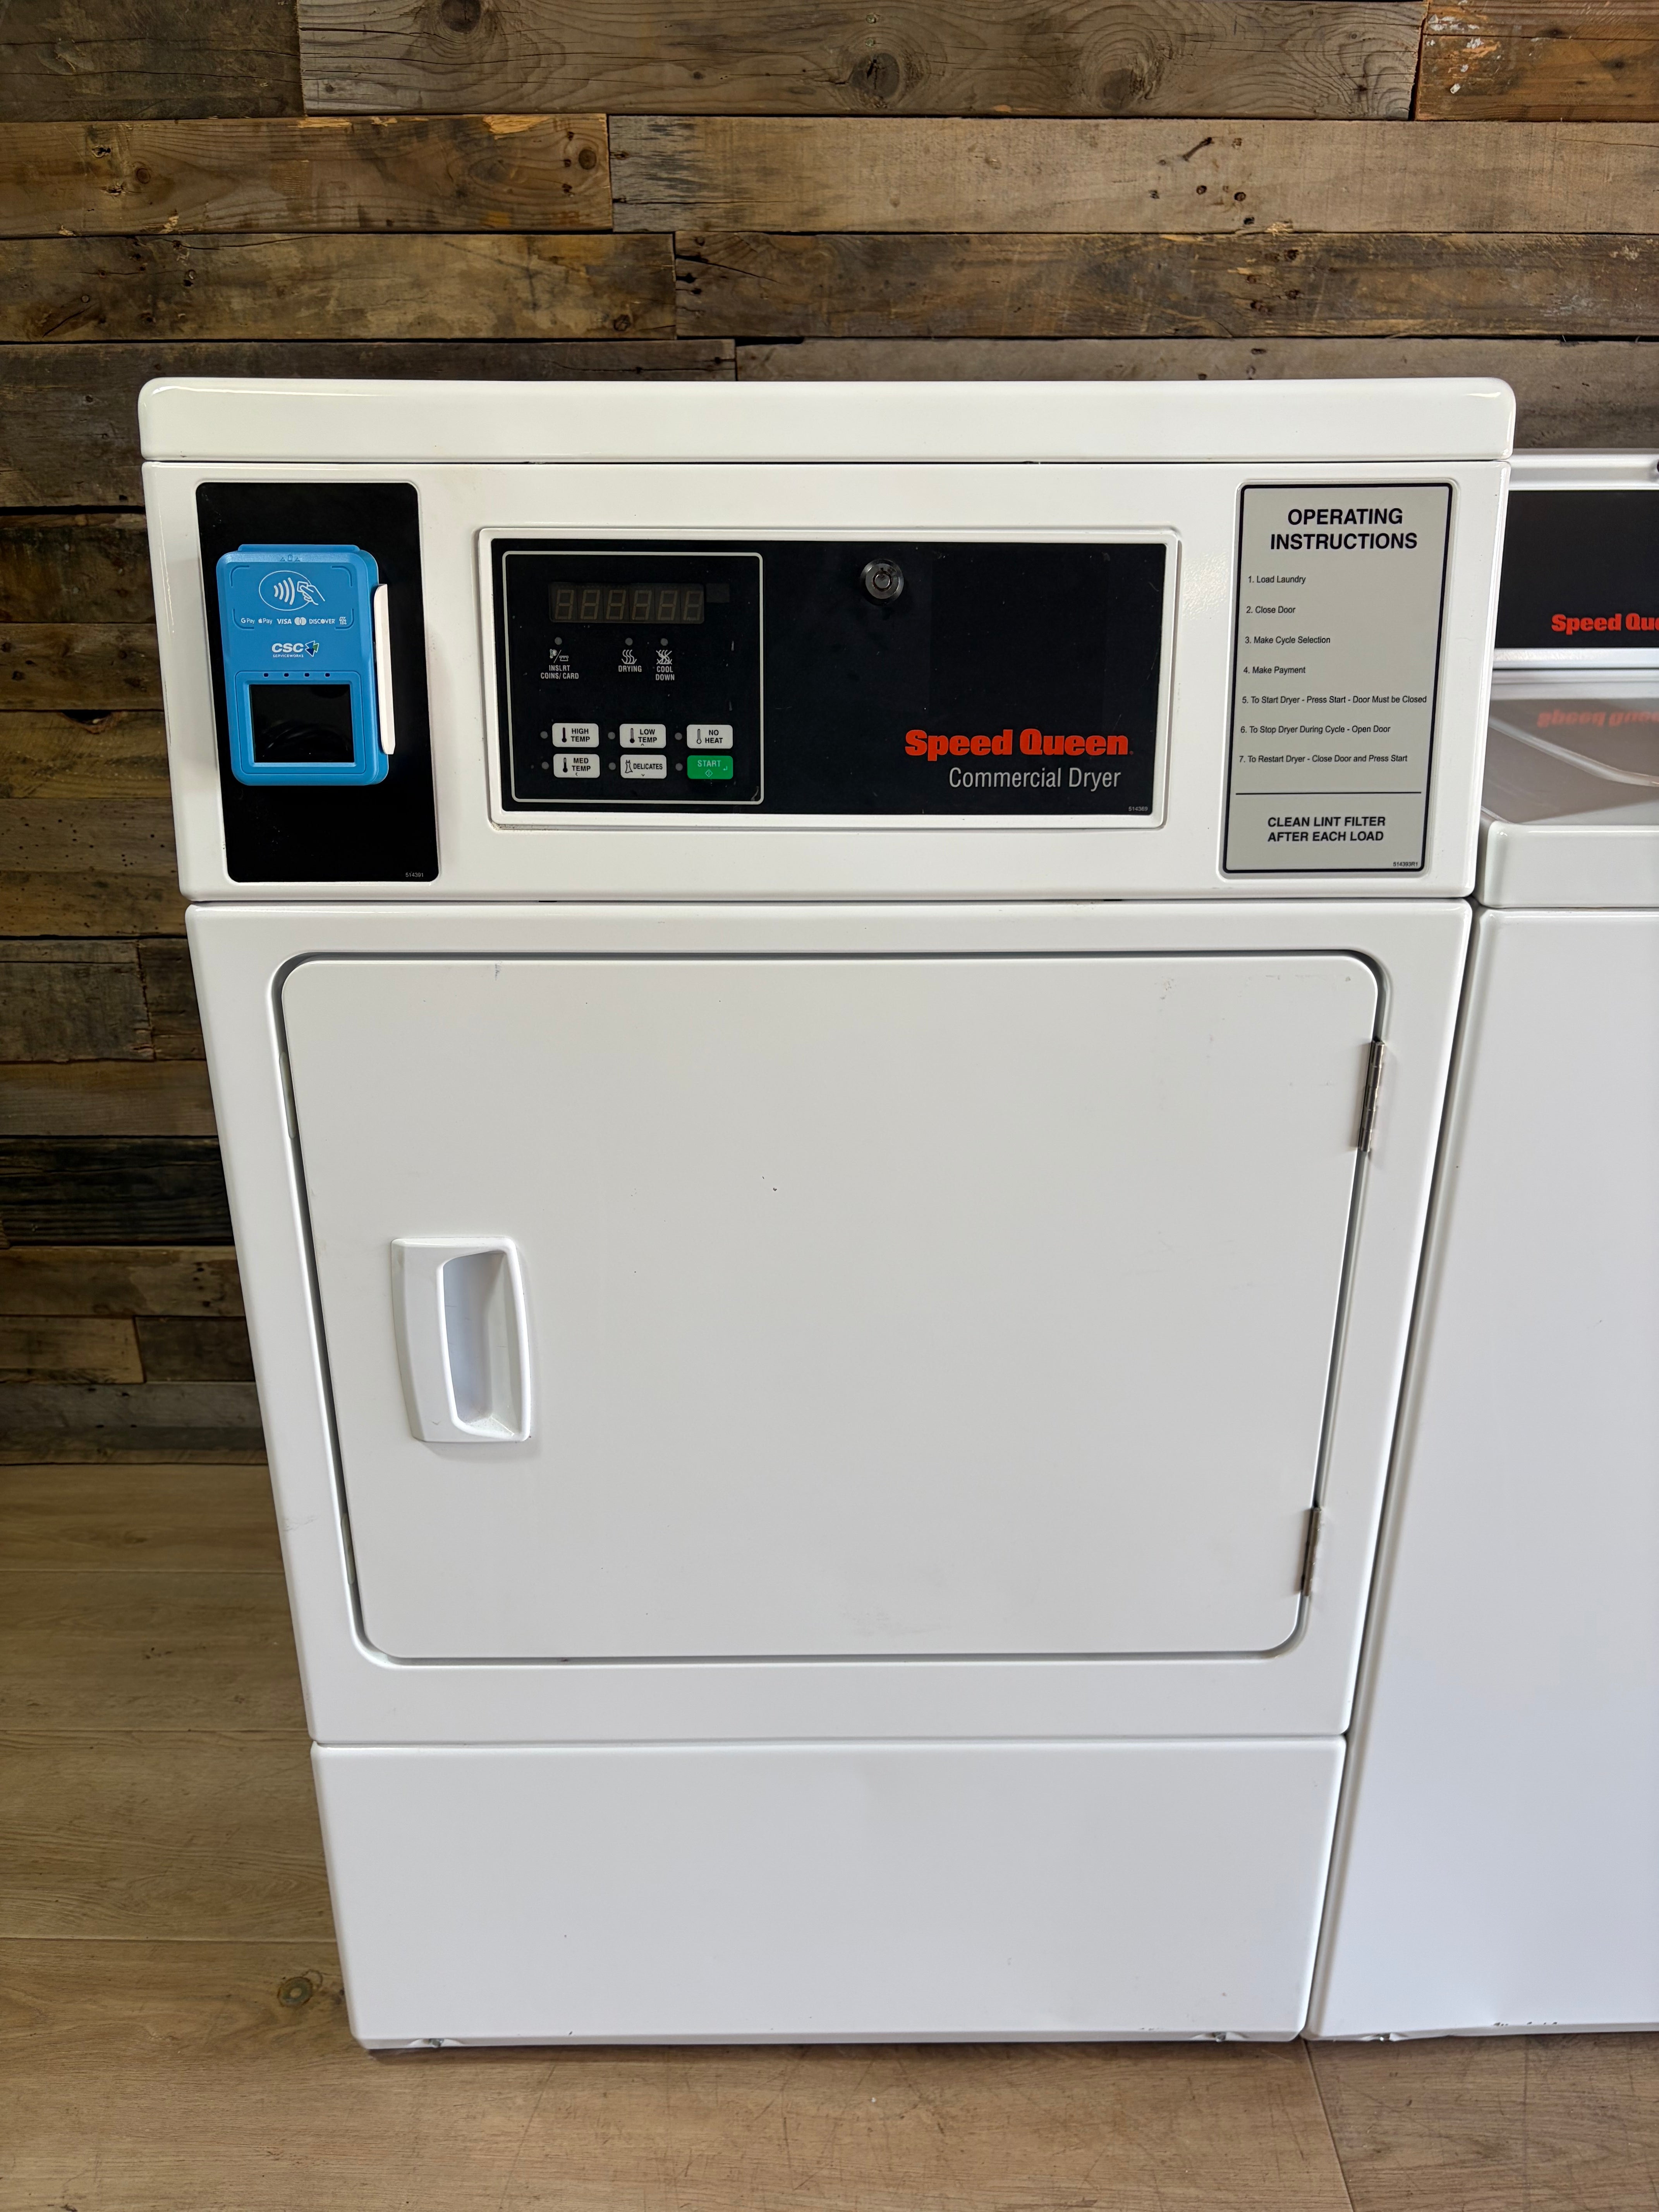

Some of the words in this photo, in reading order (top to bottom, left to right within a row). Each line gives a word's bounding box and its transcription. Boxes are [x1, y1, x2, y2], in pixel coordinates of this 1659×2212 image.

[1288, 508, 1403, 525] OPERATING
[1271, 532, 1417, 550] INSTRUCTIONS
[1276, 575, 1306, 585] Laundry
[1255, 606, 1276, 614] Close
[1551, 613, 1622, 635] Speed
[1275, 636, 1296, 646] Cycle
[271, 643, 304, 653] CSC
[1274, 666, 1306, 675] Payment
[1280, 696, 1300, 705] Dryer
[1259, 725, 1276, 735] Stop
[1278, 725, 1298, 735] Dryer
[1300, 725, 1323, 735] During
[1325, 725, 1345, 735] Cycle
[1352, 725, 1371, 734] Open
[905, 729, 1013, 761] Speed
[1020, 728, 1128, 756] Queen
[1286, 755, 1305, 764] Dryer
[1312, 754, 1333, 763] Close
[949, 767, 1061, 788] Commercial
[1069, 767, 1121, 792] Dryer
[1267, 817, 1310, 827] CLEAN
[1314, 816, 1341, 827] LINT
[1344, 816, 1386, 826] FILTER
[1267, 831, 1309, 842] AFTER
[1312, 831, 1346, 842] EACH
[1350, 831, 1384, 841] LOAD
